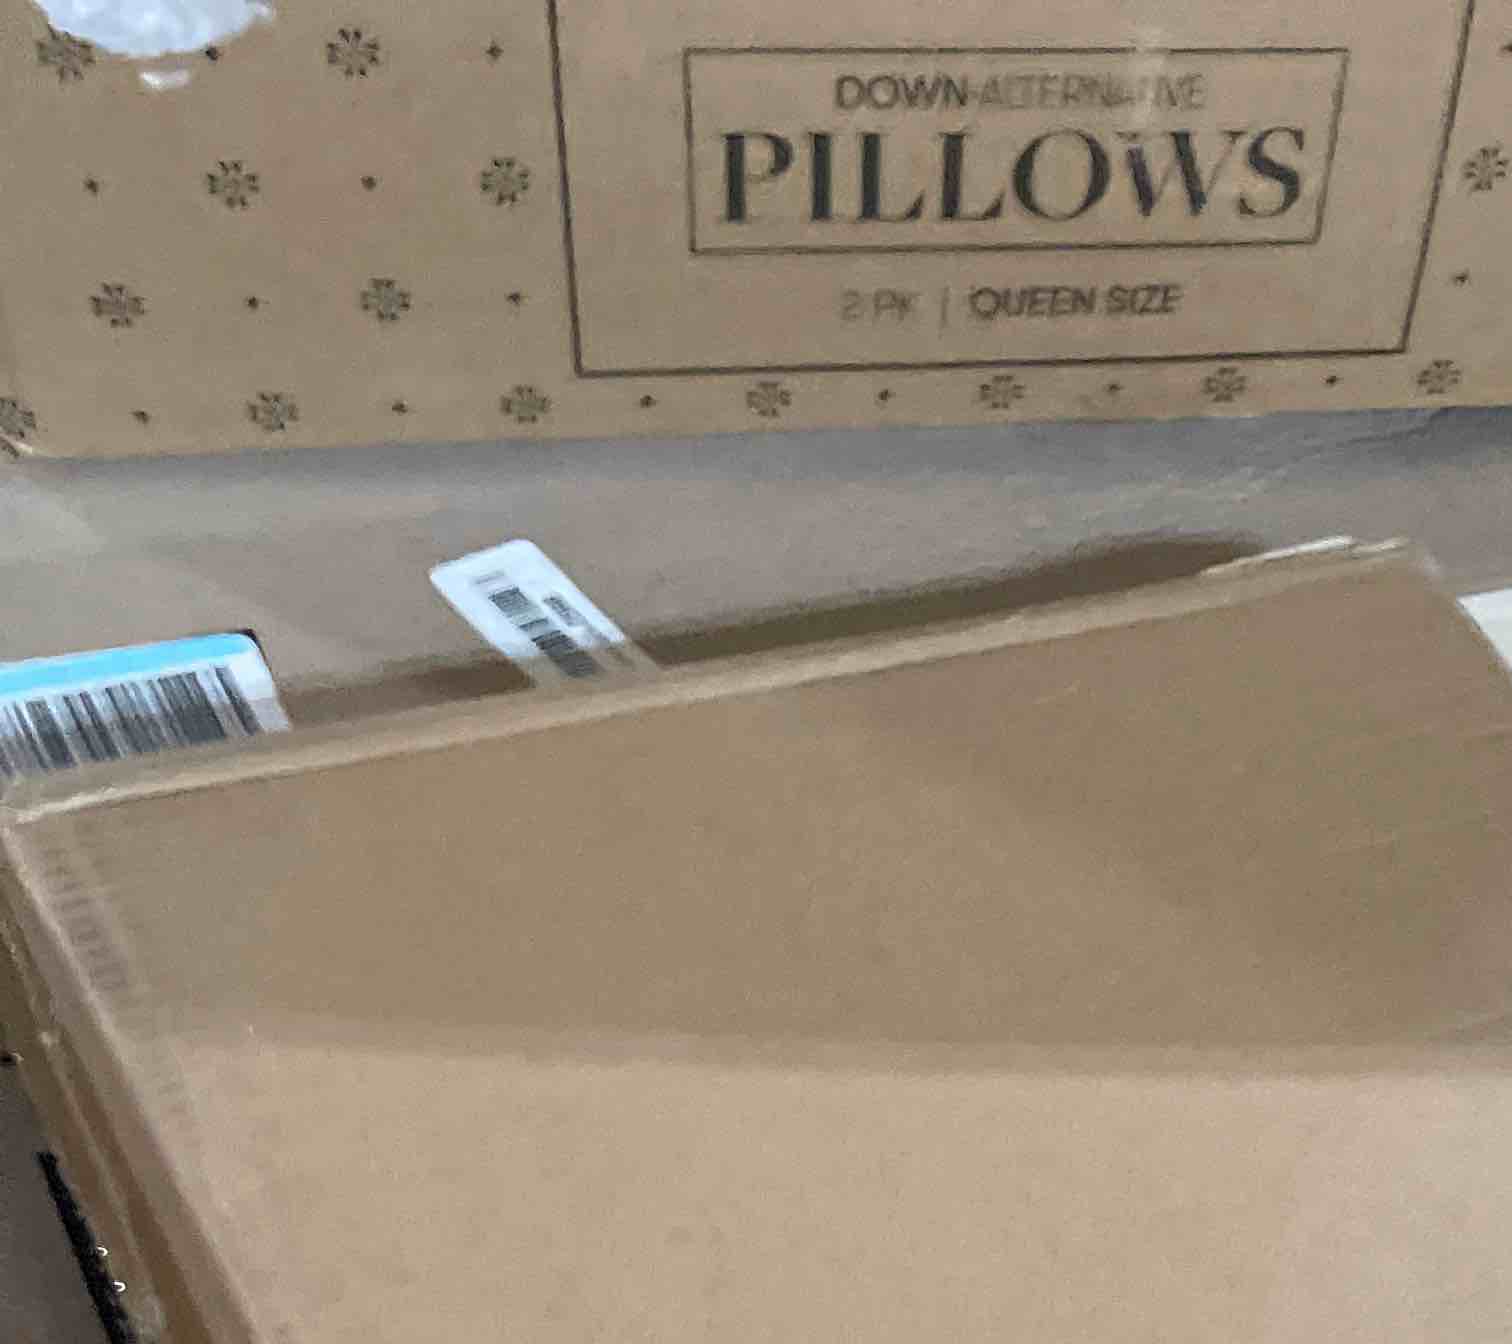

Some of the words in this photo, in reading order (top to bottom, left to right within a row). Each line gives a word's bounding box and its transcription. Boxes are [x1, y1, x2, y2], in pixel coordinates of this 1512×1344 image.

[836, 73, 969, 112] DOWN
[720, 126, 1305, 223] PILLOWS
[967, 285, 1097, 321] QUEEN
[1104, 283, 1182, 318] SIZE
